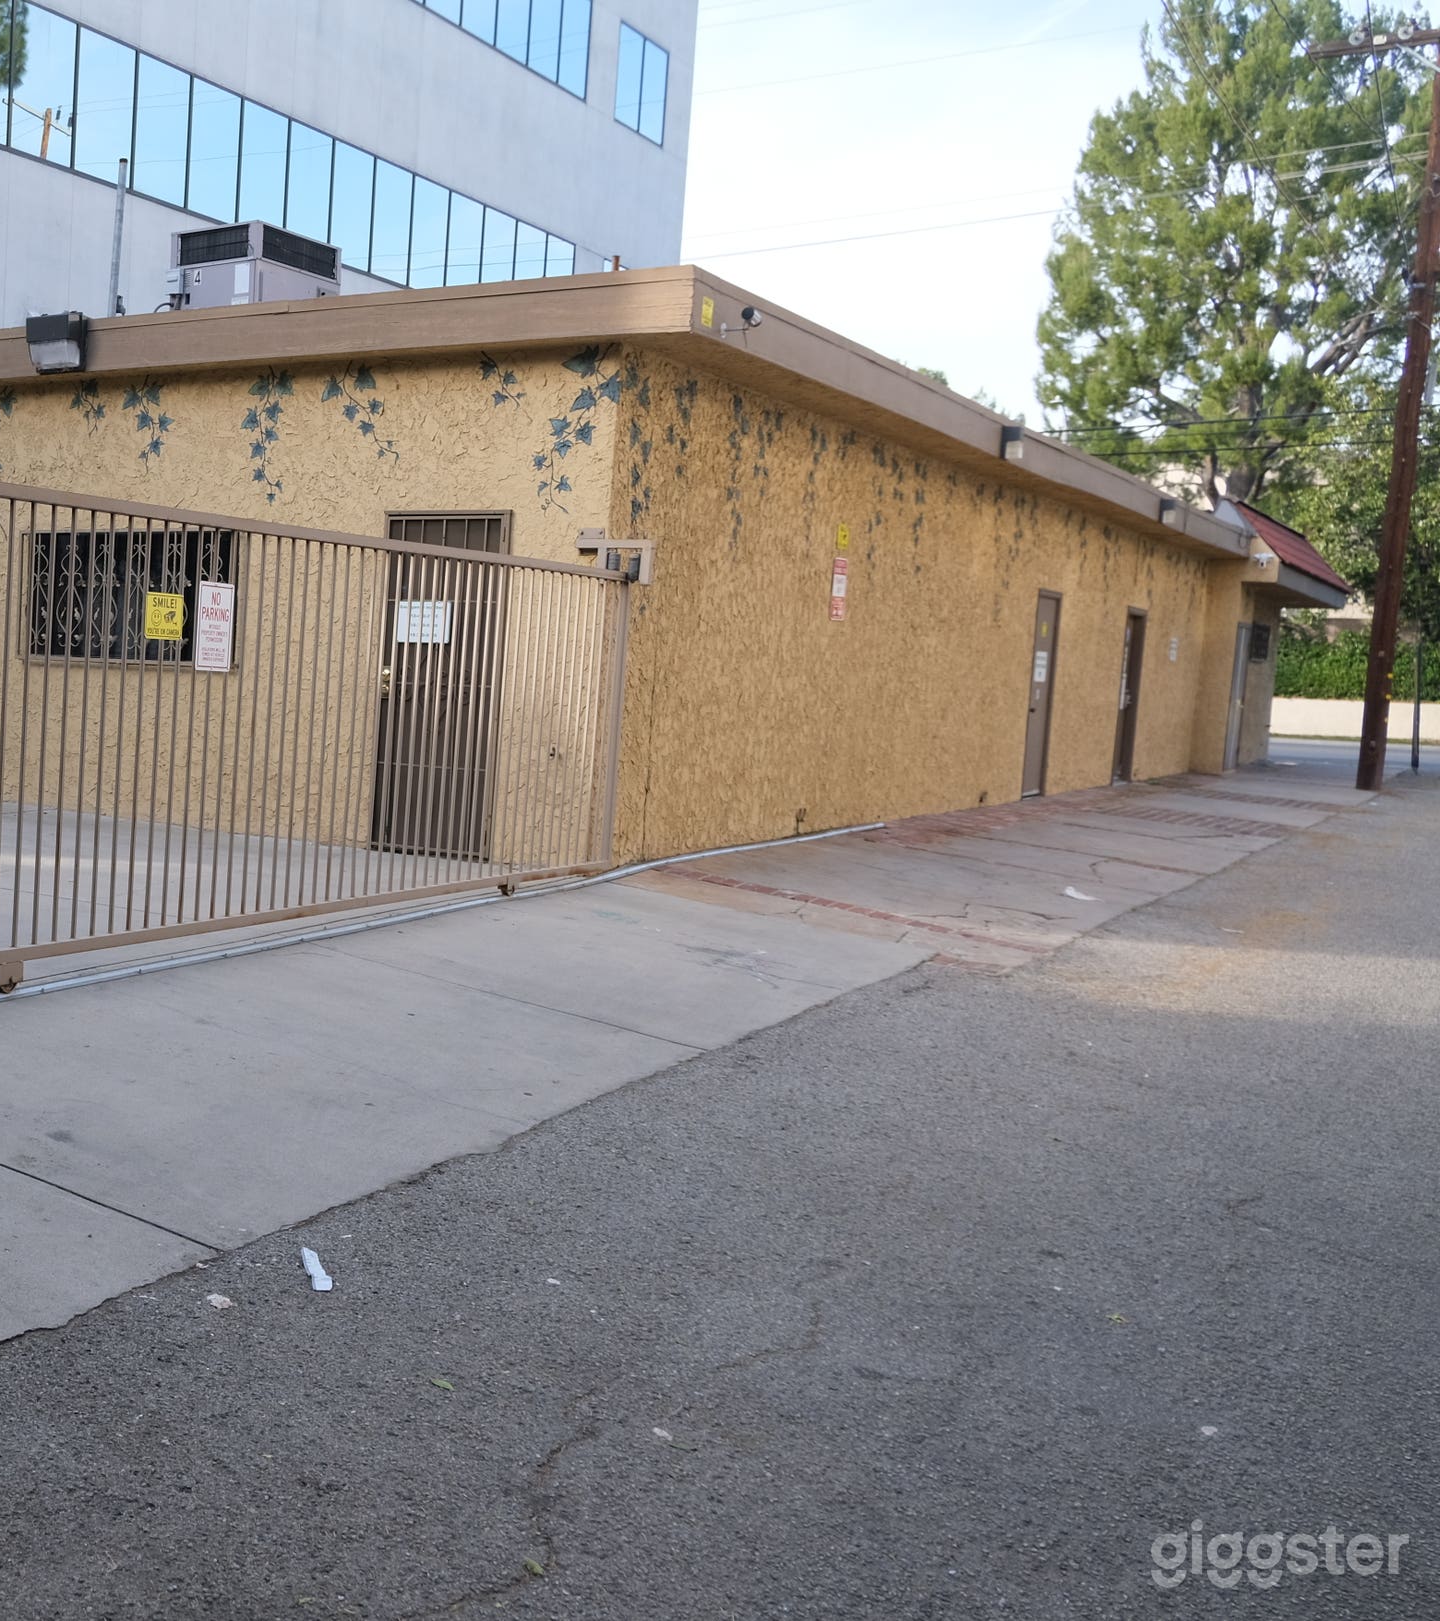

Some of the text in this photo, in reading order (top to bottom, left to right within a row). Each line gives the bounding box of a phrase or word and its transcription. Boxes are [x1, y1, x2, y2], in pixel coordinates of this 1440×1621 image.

[194, 270, 201, 283] 4
[152, 597, 178, 609] SMILE!
[211, 591, 221, 606] NO
[201, 606, 230, 622] PARKING
[166, 628, 180, 636] CAMERA
